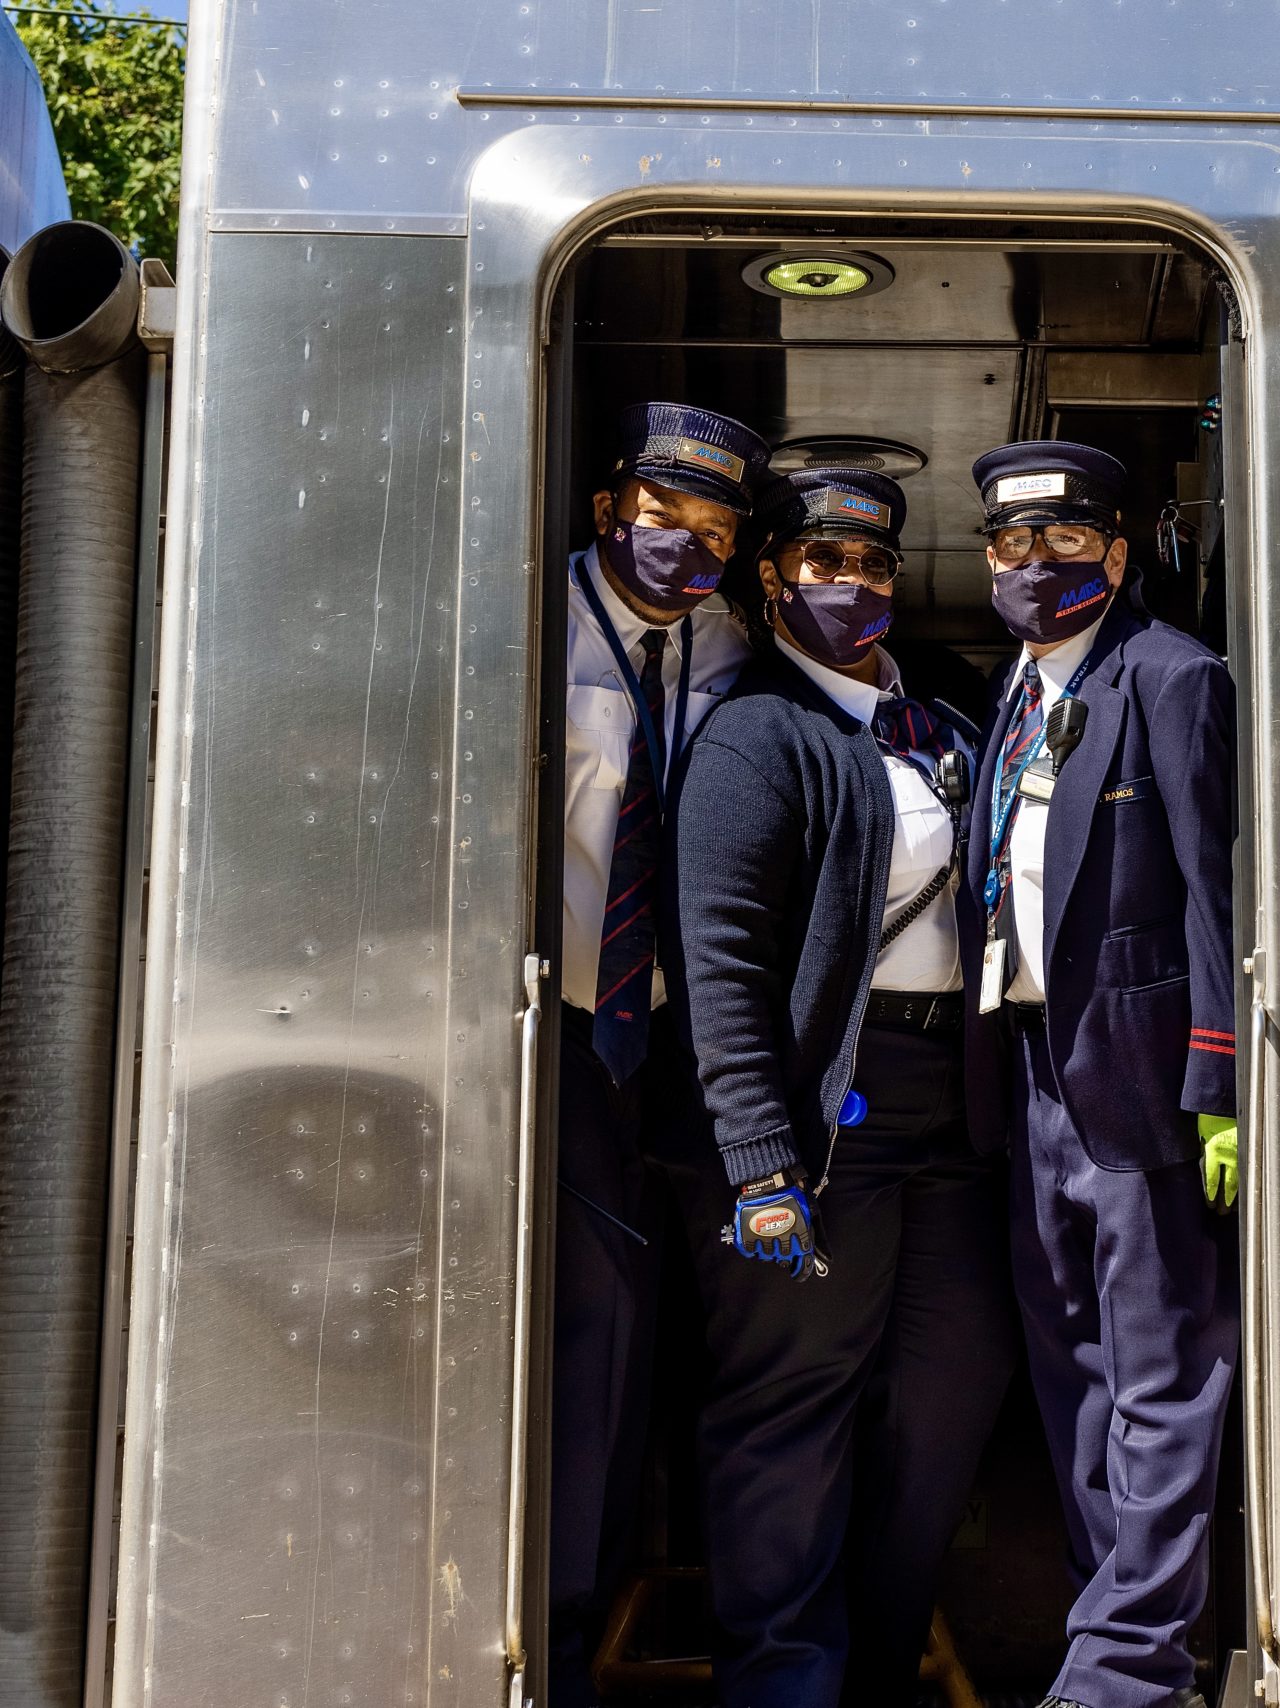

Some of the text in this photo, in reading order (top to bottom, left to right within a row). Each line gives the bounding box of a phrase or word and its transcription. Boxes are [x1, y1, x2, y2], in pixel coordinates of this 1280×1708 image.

[692, 446, 733, 469] MARC
[841, 497, 880, 515] MARC
[1056, 577, 1104, 611] MARC
[1060, 605, 1079, 616] TRAIN
[1104, 788, 1134, 801] RAMOS
